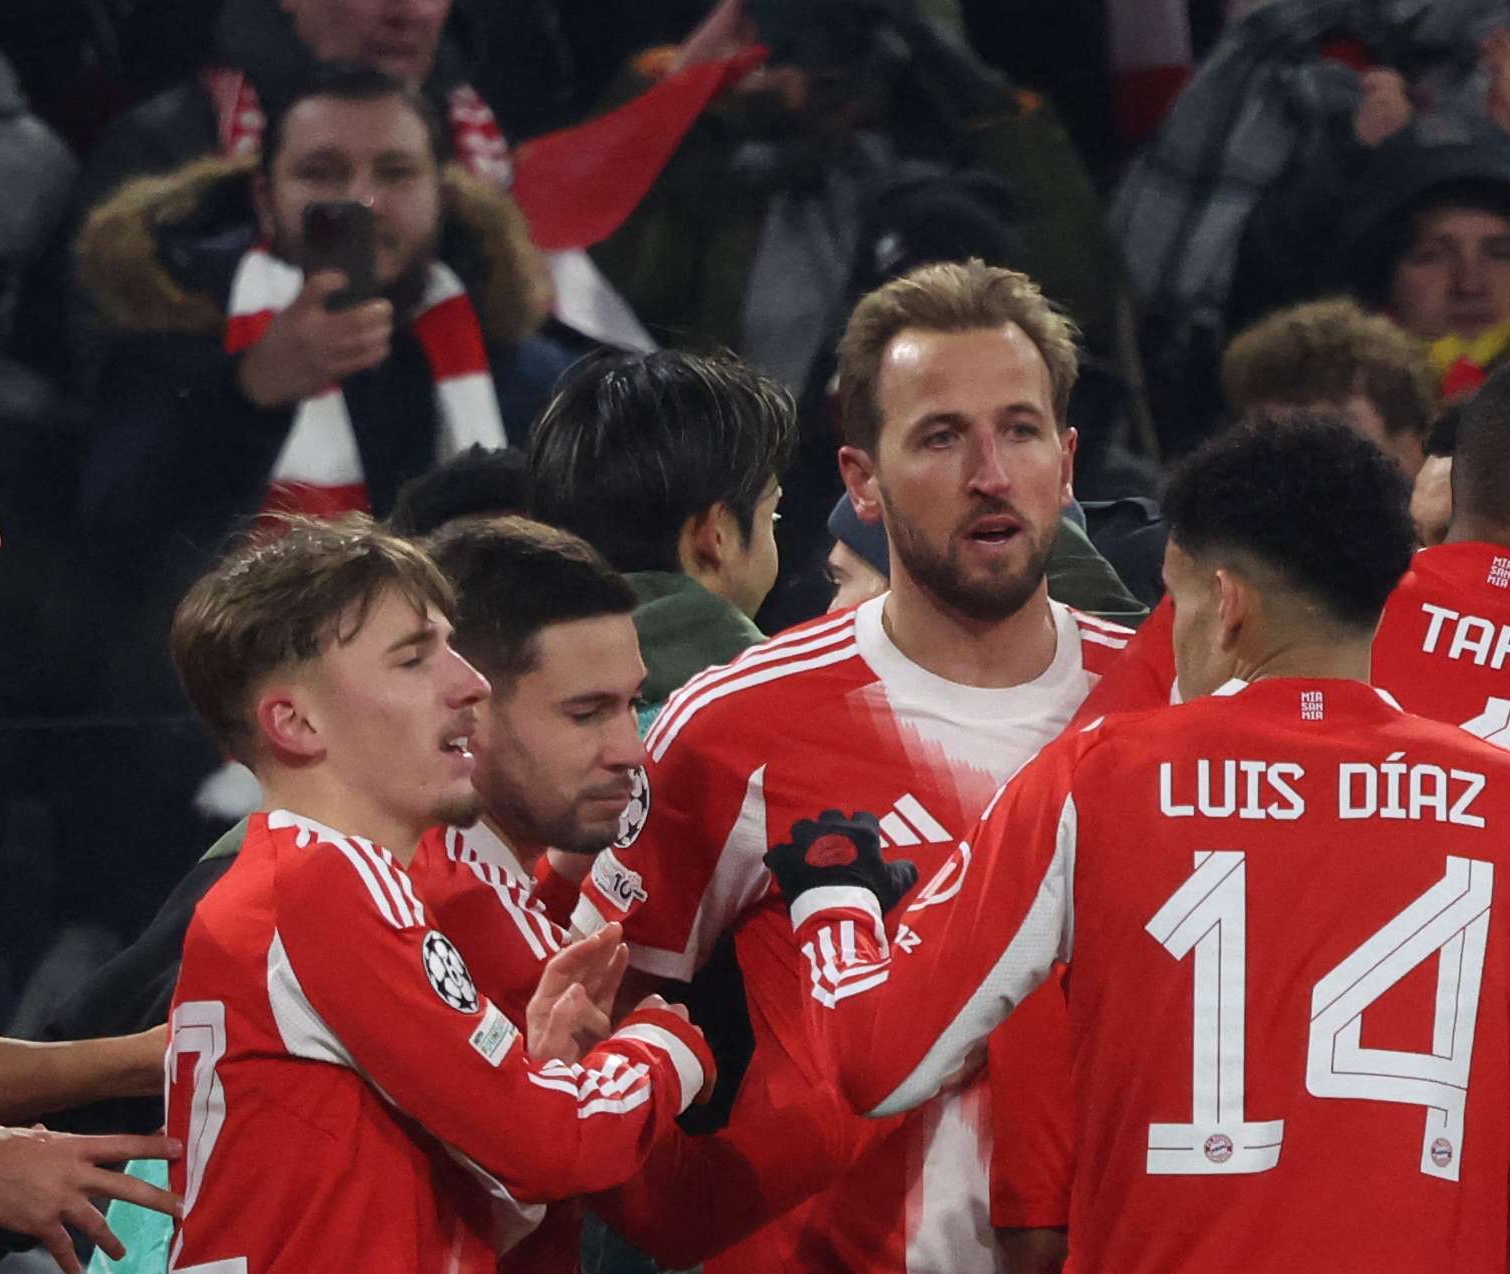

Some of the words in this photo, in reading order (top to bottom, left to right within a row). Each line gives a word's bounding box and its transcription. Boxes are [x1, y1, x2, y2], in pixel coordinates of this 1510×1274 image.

[1159, 758, 1305, 821] LUIS
[1338, 751, 1486, 829] DÍAZ
[1144, 849, 1494, 1182] 14
